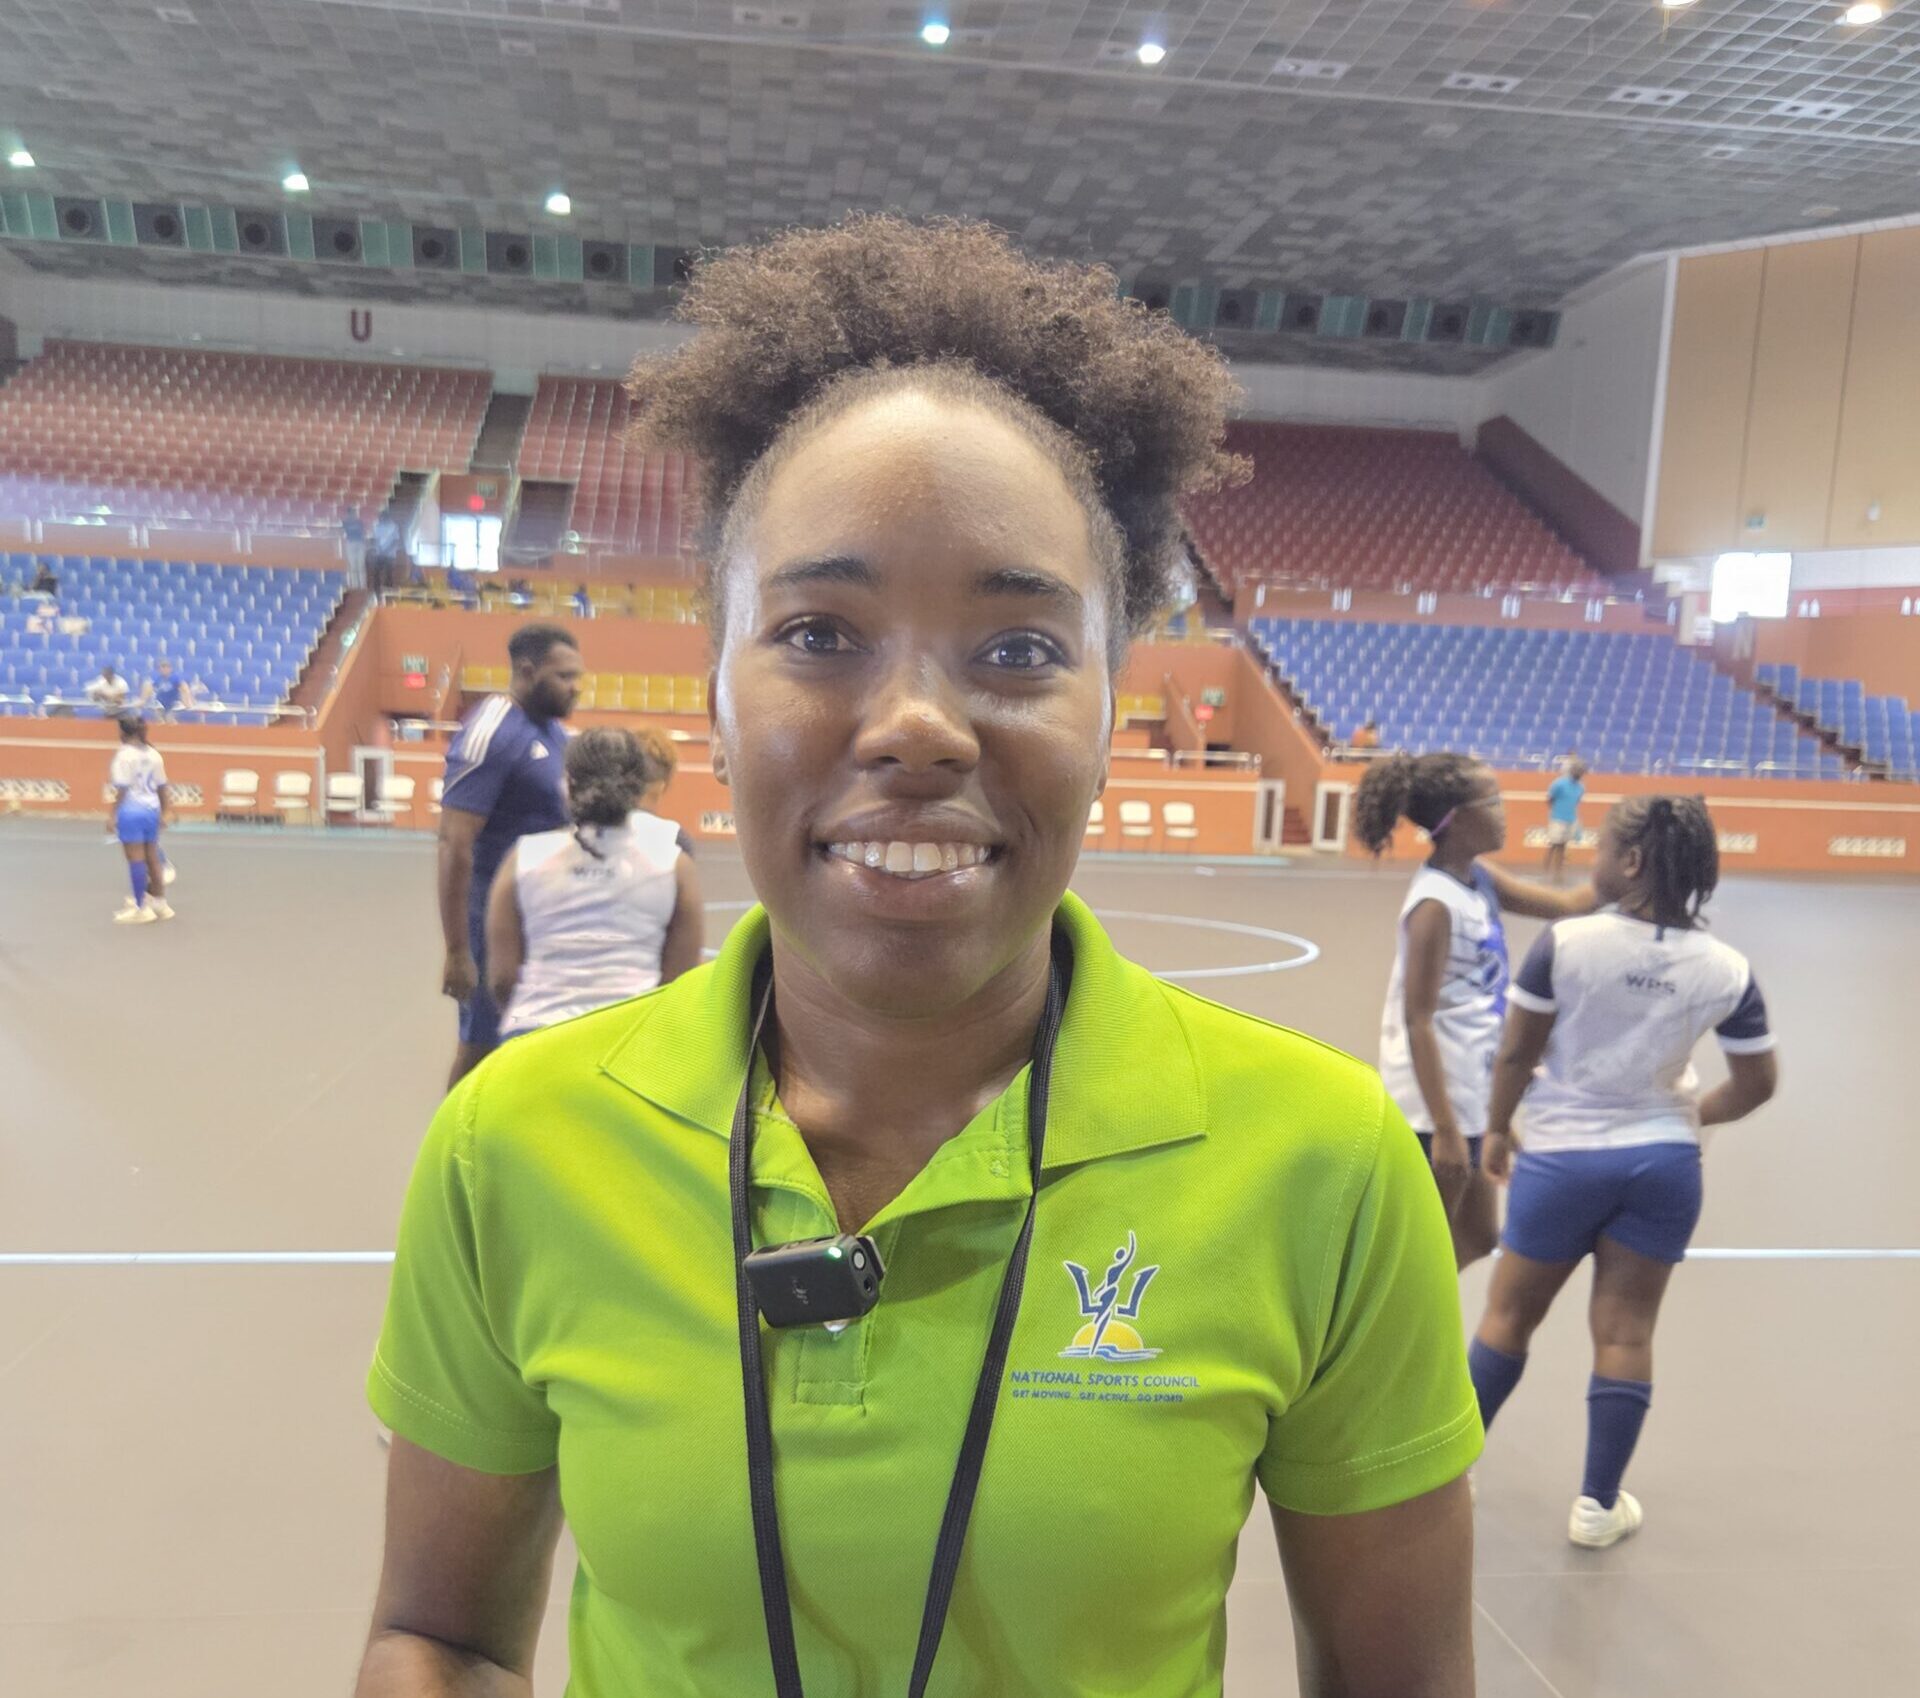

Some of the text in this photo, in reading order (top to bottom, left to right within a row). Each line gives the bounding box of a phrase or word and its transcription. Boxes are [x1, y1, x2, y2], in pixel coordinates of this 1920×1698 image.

[350, 308, 373, 343] U
[1011, 1371, 1201, 1388] NATIONAL SPORTS COUNCIL
